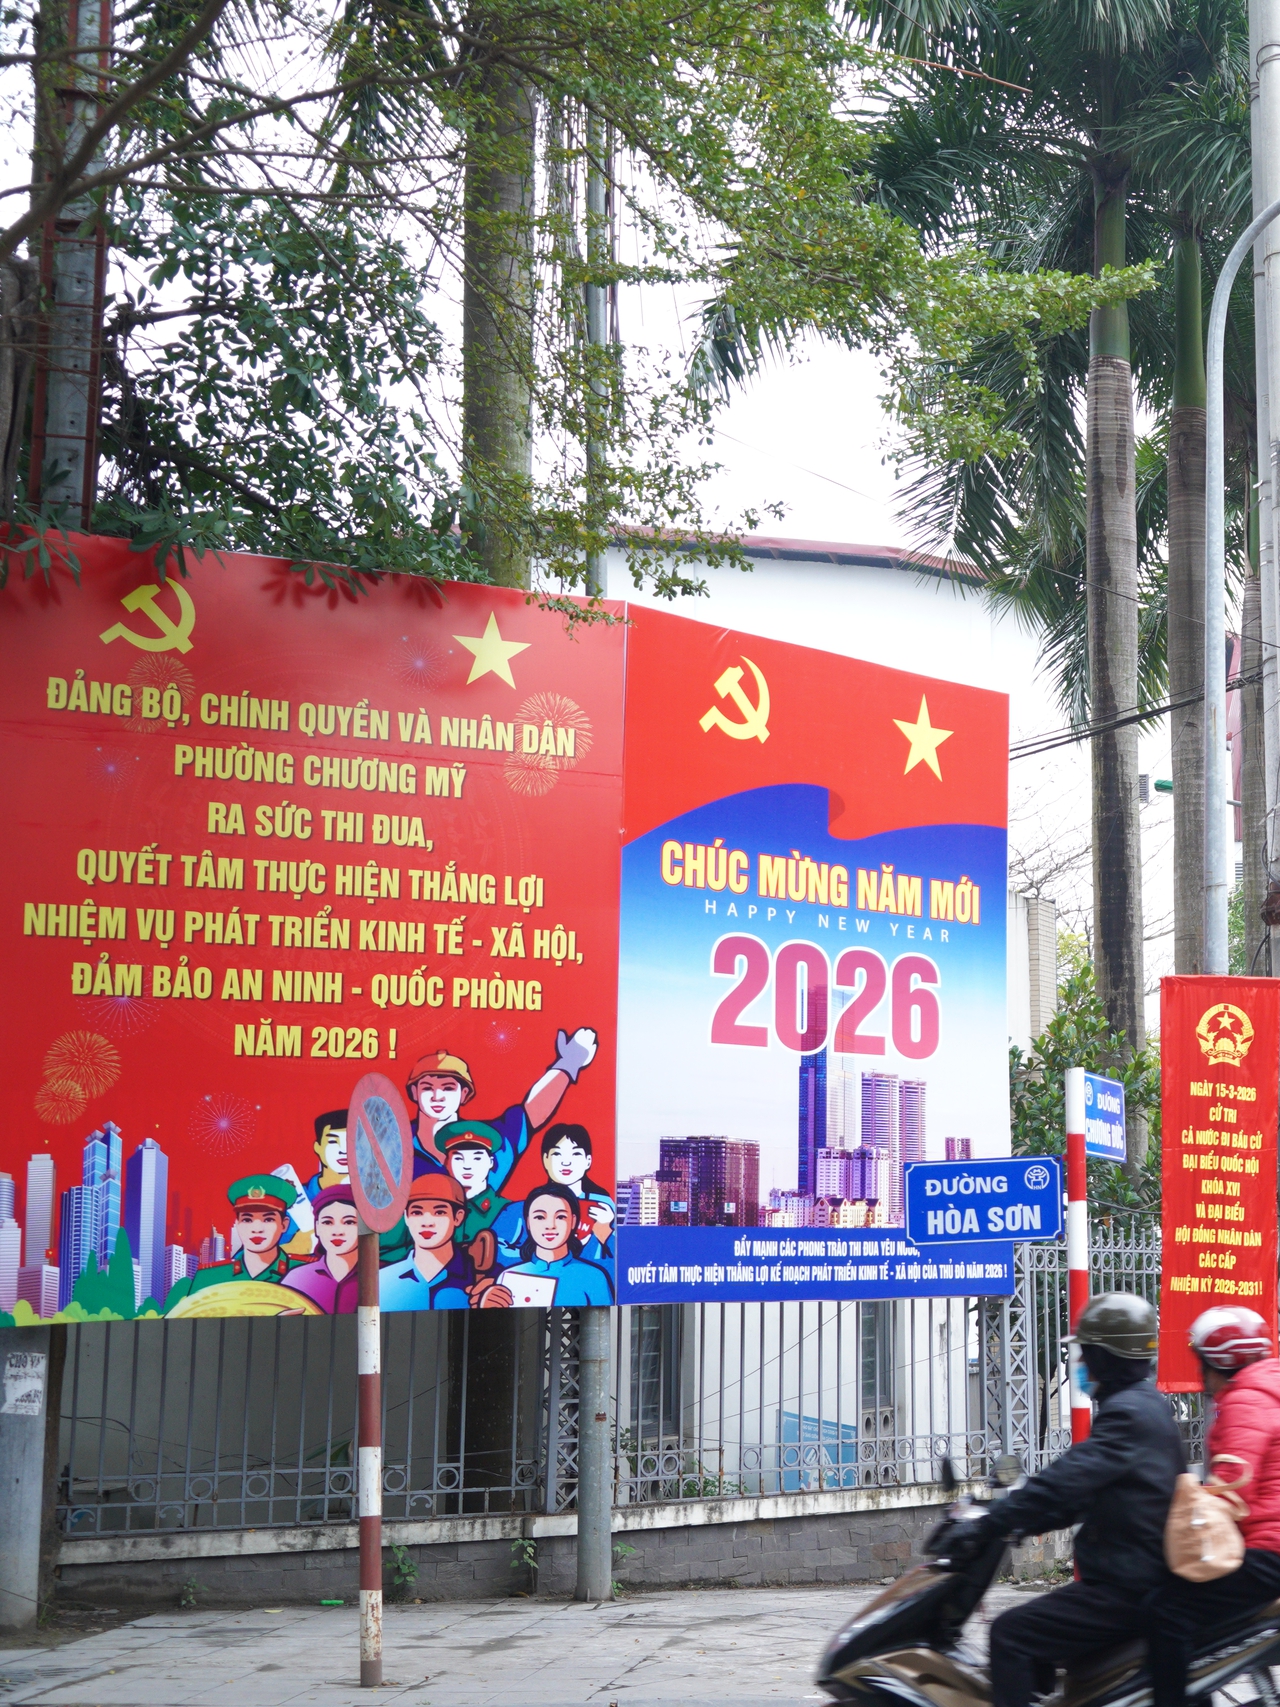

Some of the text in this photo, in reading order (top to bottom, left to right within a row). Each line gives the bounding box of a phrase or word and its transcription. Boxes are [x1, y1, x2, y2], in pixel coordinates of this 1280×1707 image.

[47, 670, 574, 756] ĐẢNG BỘ, CHÍNH QUYỀN VÀ NHÂN DÂN
[175, 743, 465, 797] PHƯỜNG CHƯƠNG MỸ
[209, 801, 432, 850] RA SỨC THI ĐUA,
[78, 844, 542, 912] QUYẾT TÂM THỰC HIỆN THẮNG LỢI
[660, 837, 981, 925] CHÚC MỪNG NĂM MỚI
[24, 900, 125, 944] NHIỆM
[137, 909, 174, 948] VỤ
[185, 907, 259, 944] PHÁT
[269, 906, 349, 948] TRIỂN
[360, 921, 424, 952] KINH
[434, 916, 464, 954] TẾ
[491, 923, 524, 957] XÃ
[534, 925, 582, 965] HỘI,
[704, 899, 951, 943] HAPPY NEW YEAR
[72, 953, 142, 996] ĐẢM
[153, 956, 211, 998] BẢO
[222, 969, 262, 1000] AN
[273, 971, 341, 1002] NINH
[372, 966, 442, 1008] QUỐC
[454, 973, 540, 1010] PHÒNG
[709, 931, 942, 1061] 2026
[235, 1020, 301, 1056] NĂM
[312, 1027, 377, 1058] 2026
[1097, 1091, 1120, 1115] ĐƯỜNG
[1190, 1079, 1257, 1101] NGÀY 15-3-2026
[1209, 1102, 1237, 1123] CỬ TRI
[1181, 1125, 1194, 1144] CẢ
[1196, 1128, 1219, 1145] NƯỚC
[1221, 1131, 1230, 1146] ĐI
[1250, 1130, 1263, 1149] CỬ
[1182, 1149, 1259, 1176] ĐẠI BIỂU QUỐC HỘI
[925, 1172, 1008, 1197] ĐƯỜNG
[1201, 1177, 1240, 1197] KHÓA XVI
[927, 1203, 1041, 1235] HÒA SƠN
[1195, 1201, 1245, 1222] VÀ ĐẠI BIỂU
[734, 1234, 751, 1257] ĐẨY
[753, 1240, 778, 1260] MẠNH
[779, 1238, 796, 1257] CÁC
[798, 1240, 826, 1257] PHONG
[827, 1238, 848, 1257] TRÀO
[849, 1240, 862, 1257] THI
[863, 1241, 879, 1257] ĐUA
[881, 1238, 896, 1257] YÊU
[1175, 1224, 1191, 1245] HỘI
[1217, 1228, 1242, 1246] NHÂN
[1243, 1229, 1262, 1246] DÂN
[628, 1261, 657, 1286] QUYẾT
[658, 1263, 678, 1283] TÂM
[680, 1265, 702, 1286] THỰC
[704, 1263, 724, 1286] HIỆN
[726, 1261, 754, 1282] THẮNG
[755, 1264, 769, 1286] LỢI
[770, 1261, 782, 1282] KẾ
[783, 1266, 810, 1285] HOẠCH
[812, 1263, 832, 1281] PHÁT
[834, 1260, 857, 1281] TRIỂN
[859, 1265, 877, 1281] KINH
[879, 1260, 890, 1280] TẾ
[895, 1262, 907, 1280] XÃ
[908, 1262, 920, 1283] HỘI
[922, 1259, 937, 1280] CỦA
[938, 1259, 954, 1280] THỦ
[955, 1262, 965, 1279] ĐÔ
[966, 1261, 984, 1279] NĂM
[985, 1264, 1003, 1279] 2026
[1199, 1250, 1237, 1270] CÁC CẤP
[1170, 1274, 1199, 1295] NHIỆM
[1200, 1275, 1213, 1292] KỲ
